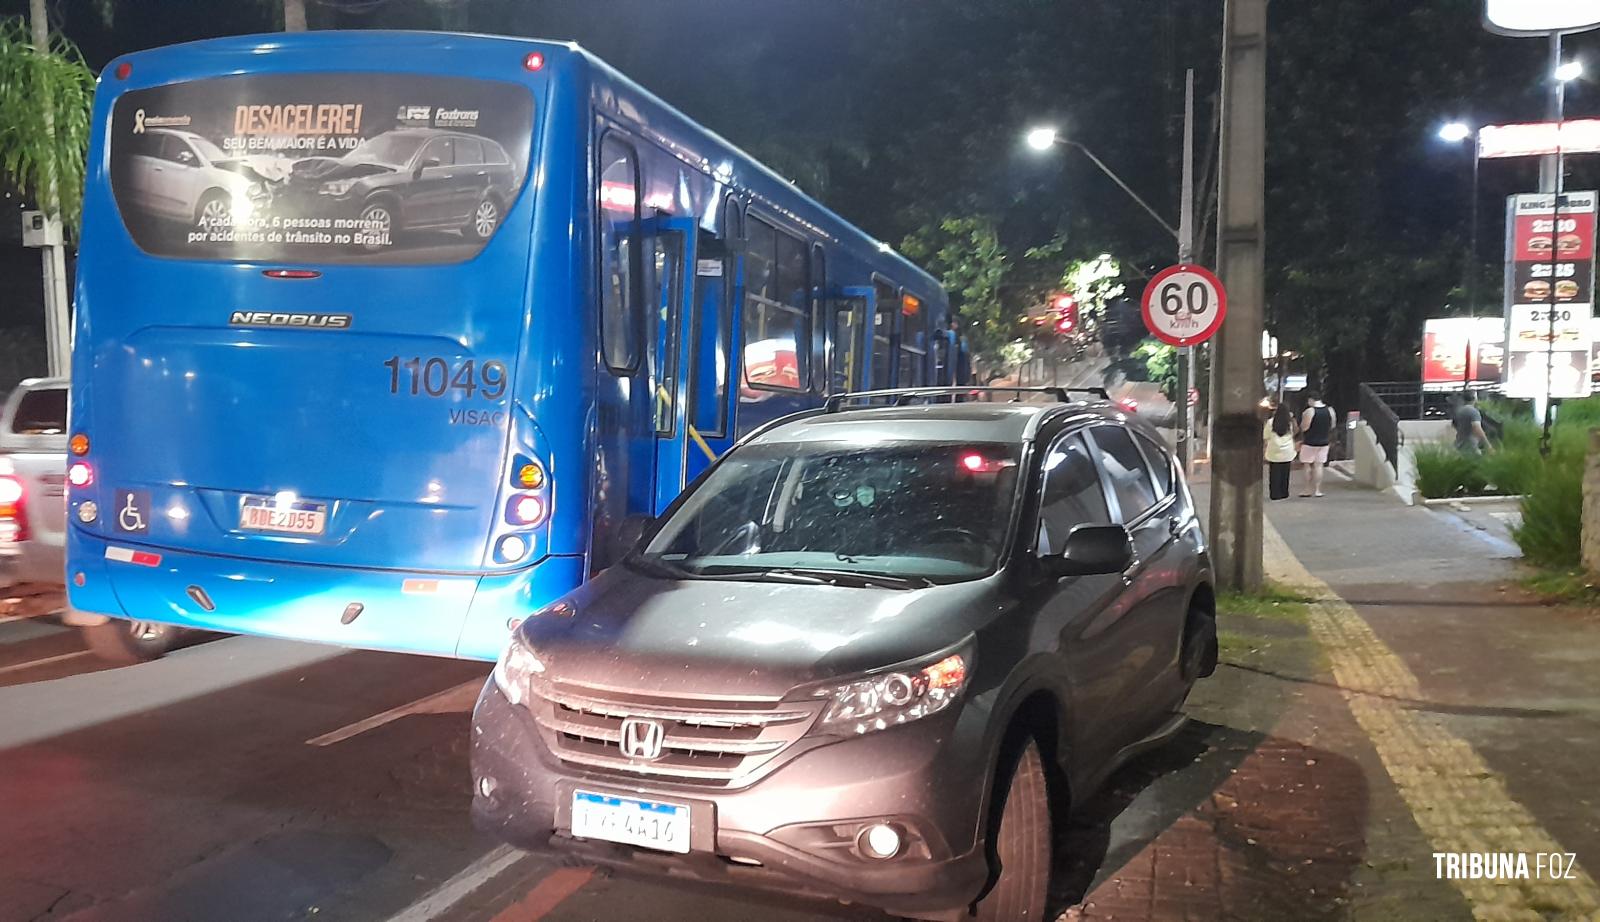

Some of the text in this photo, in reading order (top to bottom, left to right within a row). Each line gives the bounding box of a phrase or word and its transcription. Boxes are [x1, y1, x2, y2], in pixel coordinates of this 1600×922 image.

[234, 104, 363, 135] DESACELERE!
[222, 137, 247, 150] SEU
[275, 137, 316, 150] MAIOR
[316, 135, 325, 150] É
[326, 137, 337, 150] A
[339, 137, 367, 150] VIDA
[210, 216, 235, 226] cad
[272, 216, 281, 227] 6
[283, 217, 332, 229] pessoas
[334, 217, 384, 229] morrem
[187, 230, 393, 245] por acidentes de trânsito no Brasil.
[1160, 282, 1209, 316] 60
[231, 311, 349, 329] NEOBUS
[383, 355, 507, 401] 11049
